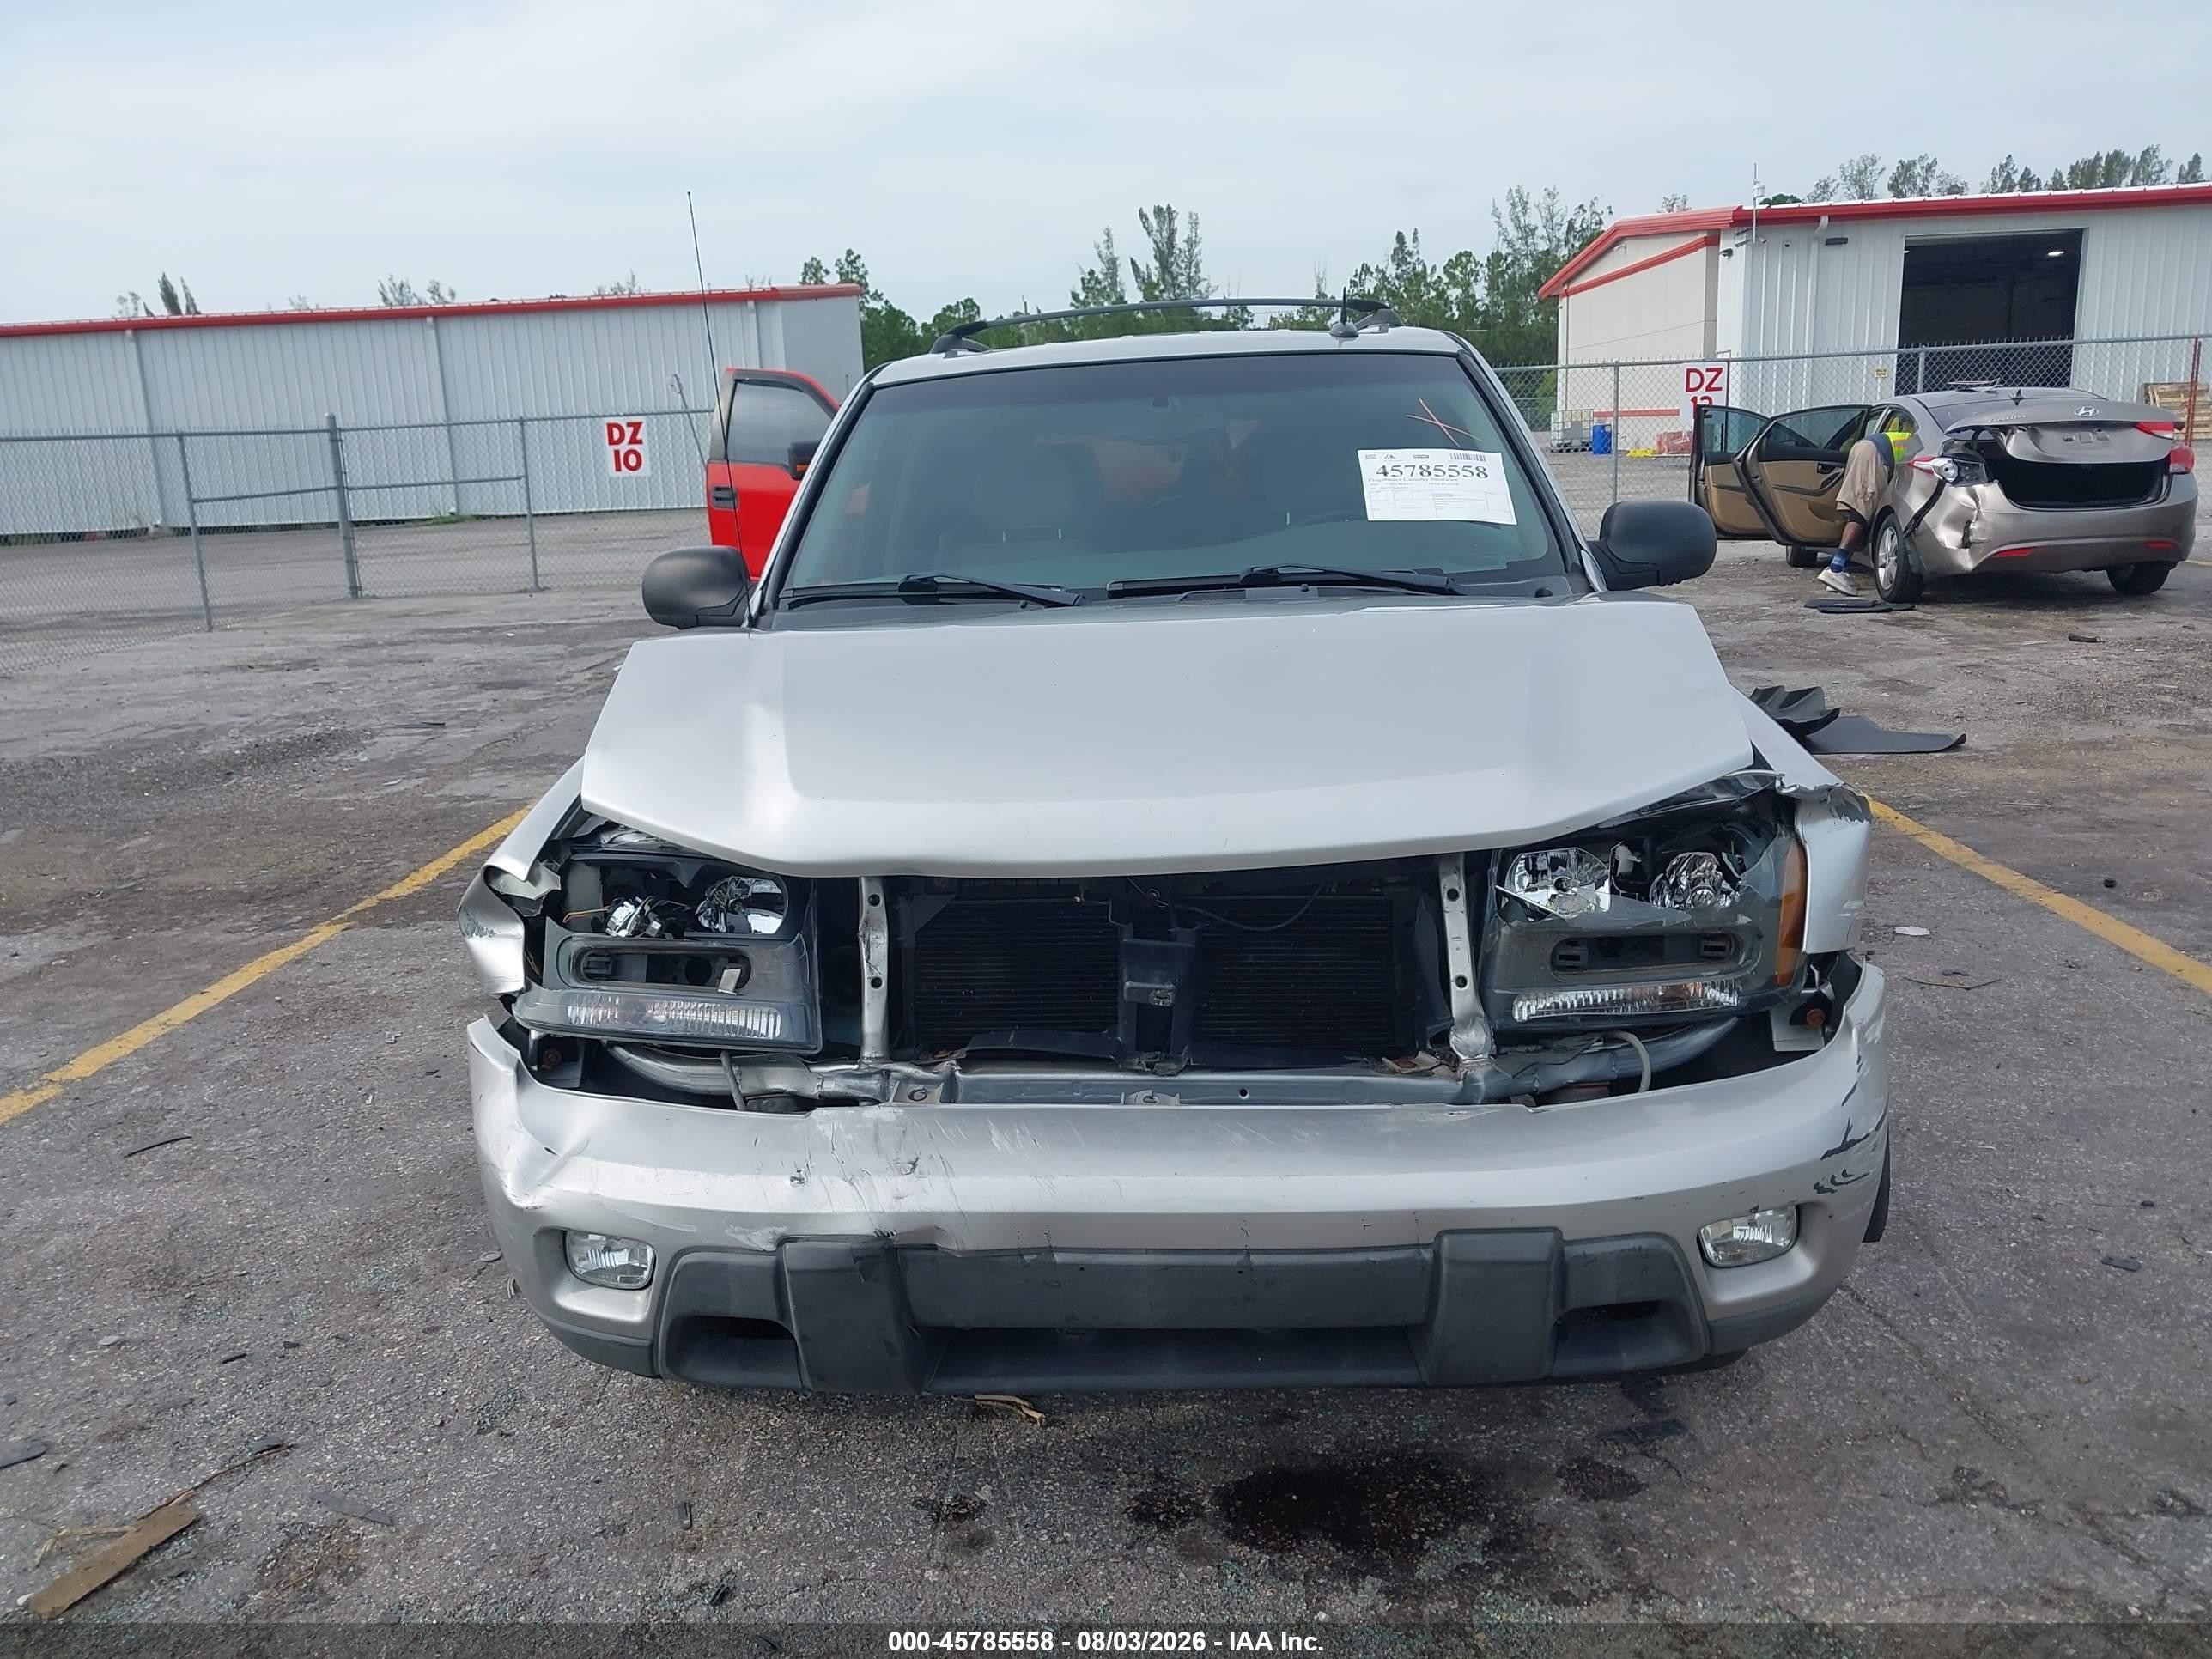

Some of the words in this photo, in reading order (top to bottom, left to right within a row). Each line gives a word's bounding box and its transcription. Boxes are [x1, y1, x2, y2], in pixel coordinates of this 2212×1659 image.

[1685, 367, 1723, 392] DZ
[606, 421, 643, 446] DZ
[1376, 464, 1488, 479] 45785558
